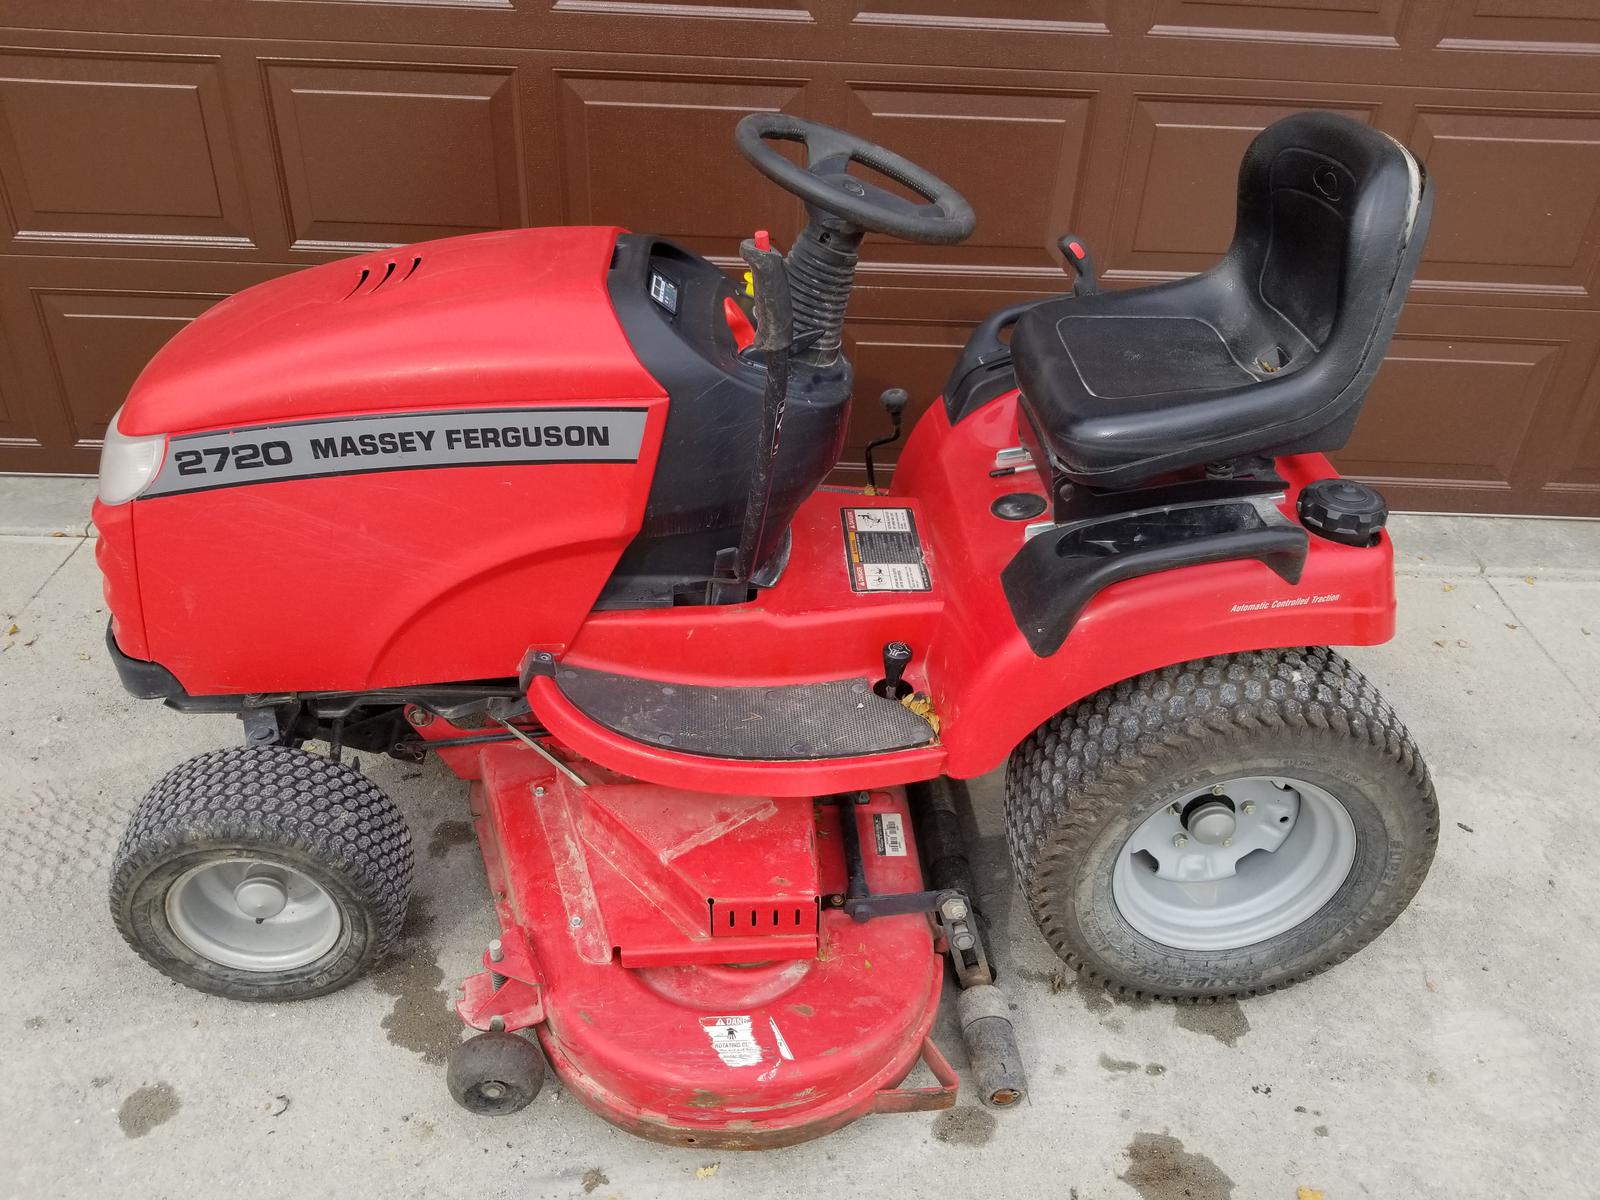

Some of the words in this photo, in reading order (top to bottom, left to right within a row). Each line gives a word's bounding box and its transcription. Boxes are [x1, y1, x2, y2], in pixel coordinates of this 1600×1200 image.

[174, 440, 293, 476] 2720
[310, 430, 436, 460] MASSEY
[445, 425, 610, 450] FERGUSON
[1230, 602, 1270, 613] Automatic
[1271, 596, 1311, 609] Controlled
[1311, 593, 1340, 604] Traction
